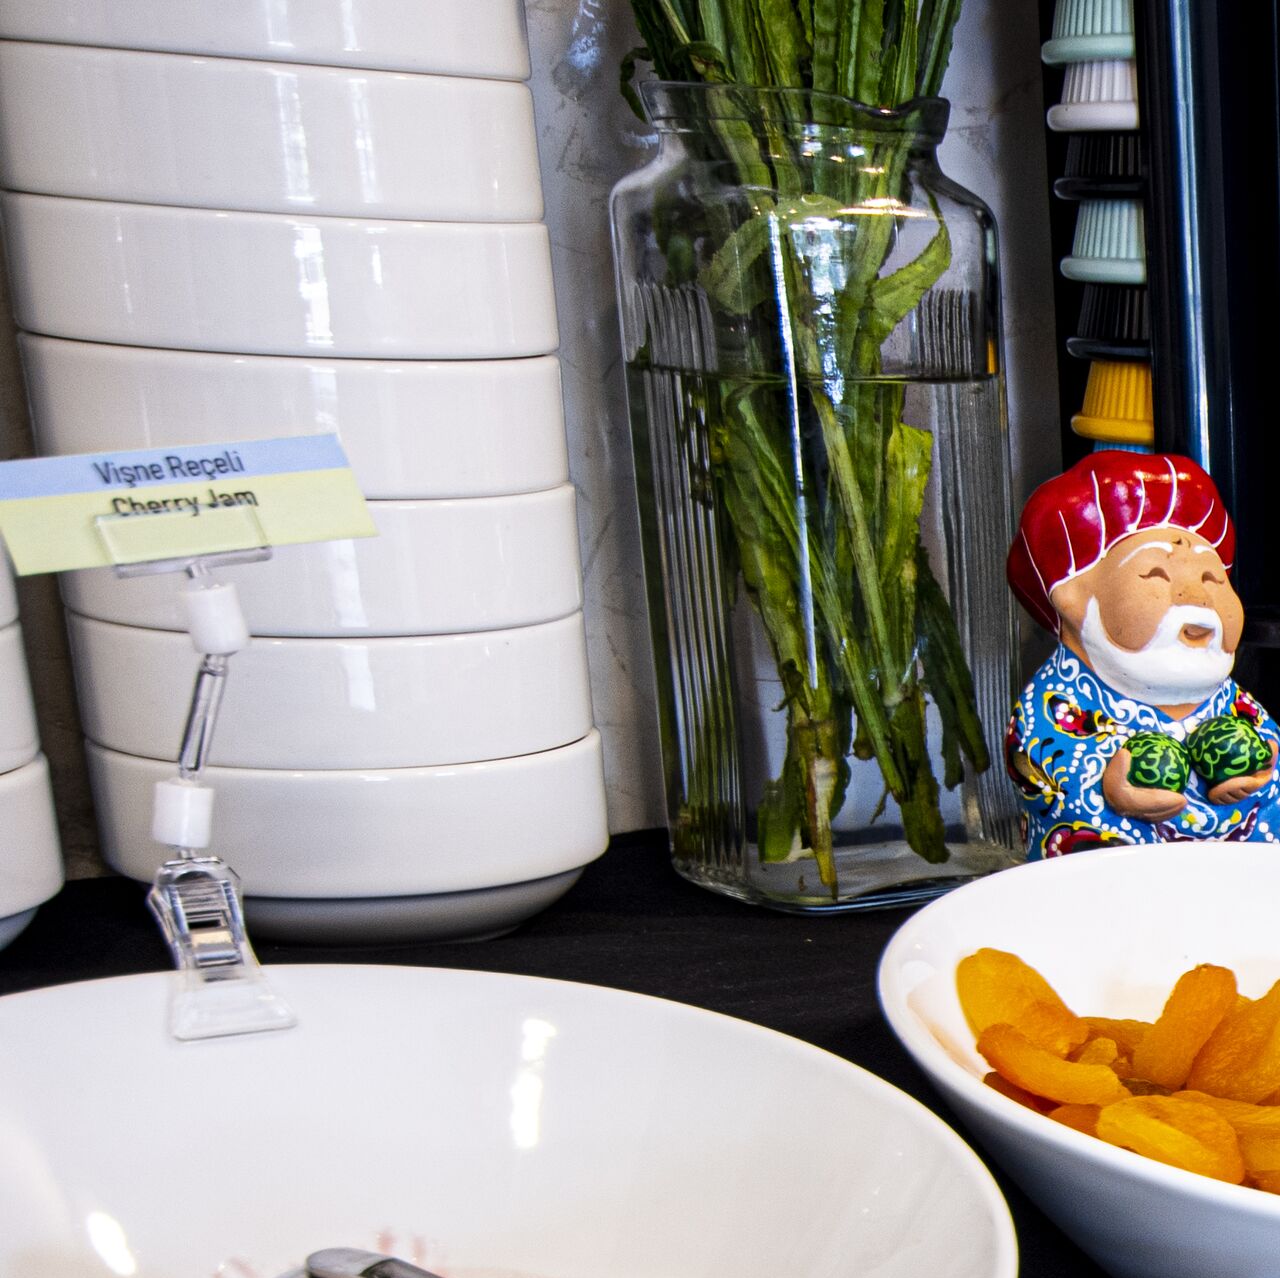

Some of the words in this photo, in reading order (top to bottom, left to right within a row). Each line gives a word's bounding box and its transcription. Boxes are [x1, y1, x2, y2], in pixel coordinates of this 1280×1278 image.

[93, 459, 165, 488] Vişne
[165, 450, 245, 482] Reçeli
[111, 493, 200, 518] Cherry
[207, 487, 260, 509] Jam
